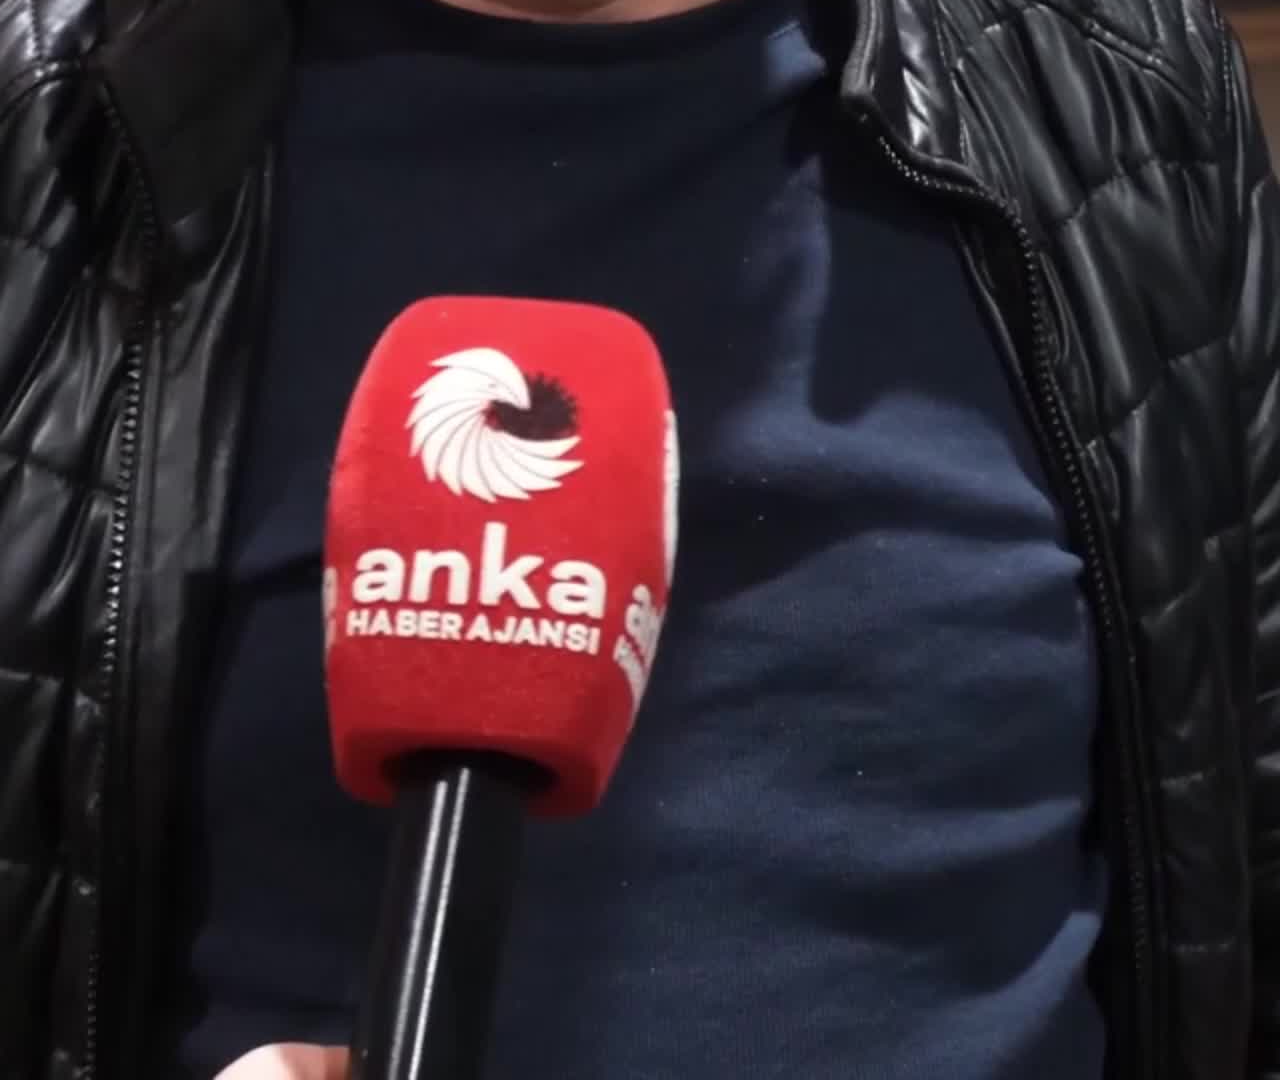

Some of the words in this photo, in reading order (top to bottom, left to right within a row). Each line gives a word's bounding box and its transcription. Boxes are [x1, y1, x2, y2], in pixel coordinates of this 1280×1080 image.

[351, 521, 608, 619] anka
[346, 608, 463, 640] HABER
[465, 612, 601, 656] AJANSI
